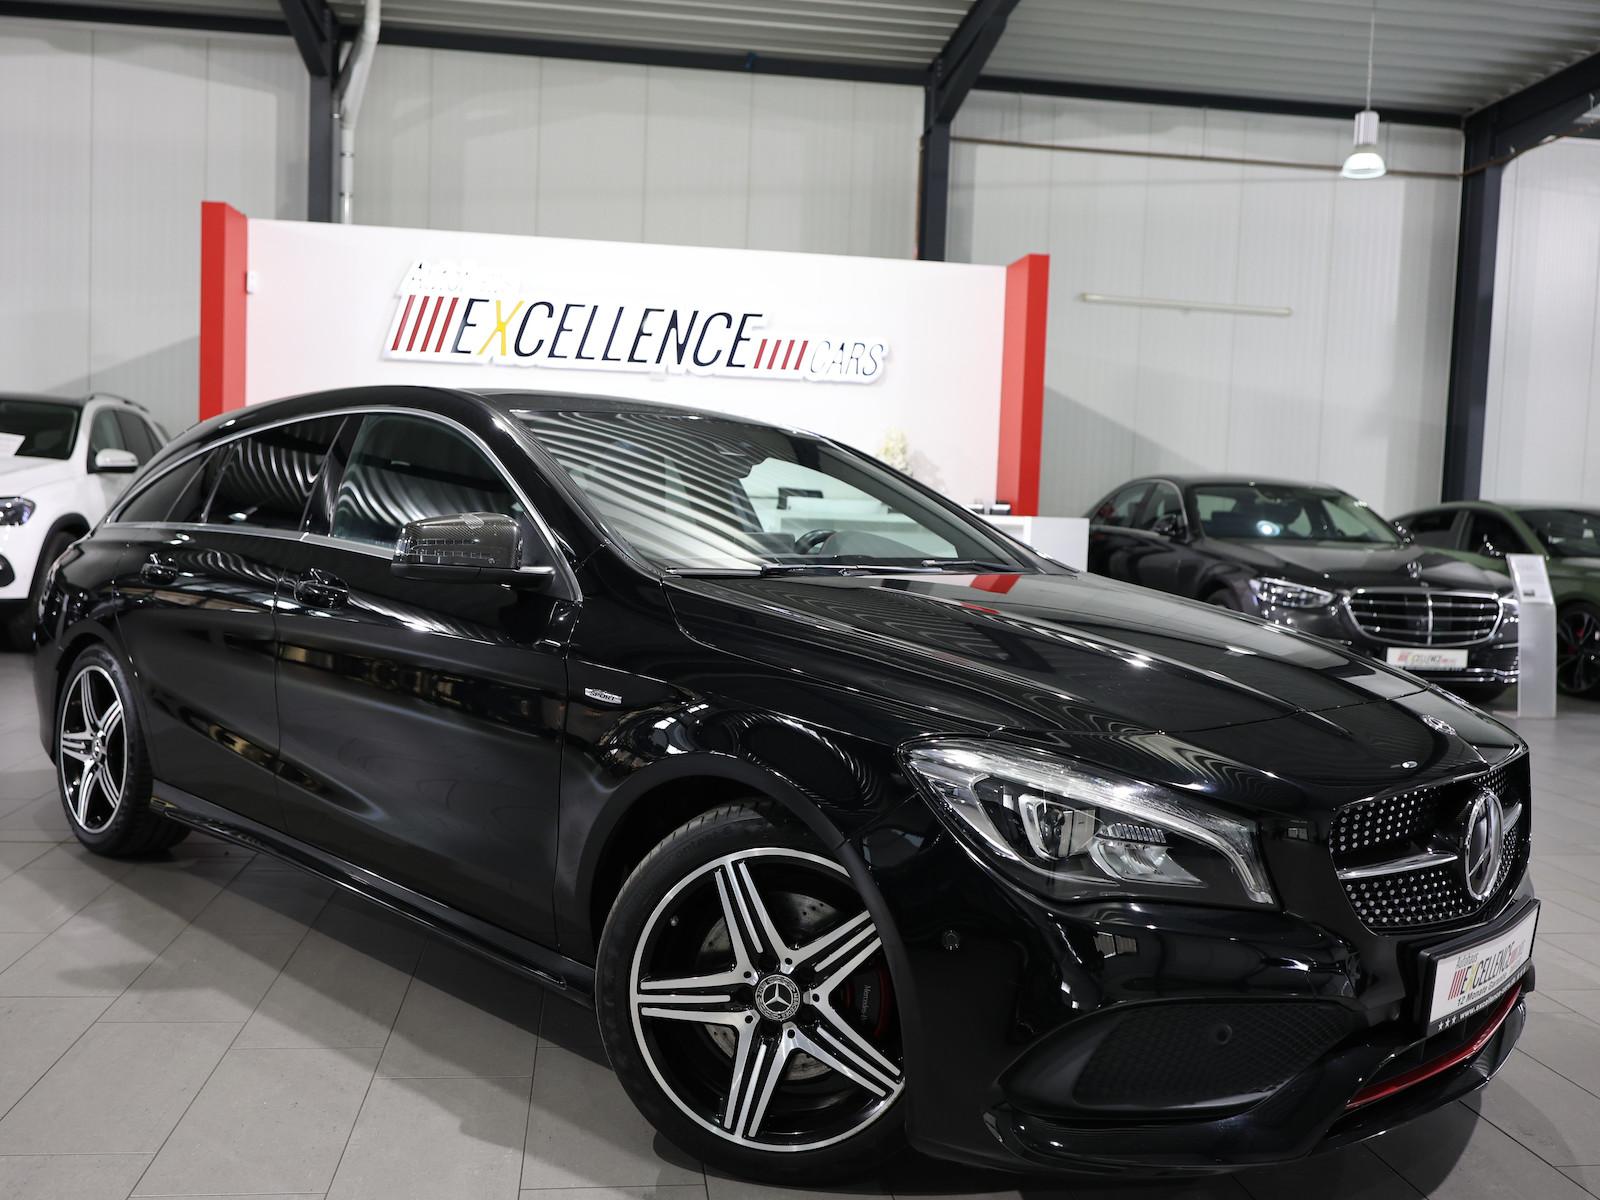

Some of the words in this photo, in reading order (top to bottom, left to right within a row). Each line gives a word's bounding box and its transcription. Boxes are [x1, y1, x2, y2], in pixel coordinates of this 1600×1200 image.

[450, 297, 764, 369] EXCELLENCE
[810, 339, 884, 377] CARS
[1457, 997, 1466, 1007] 12
